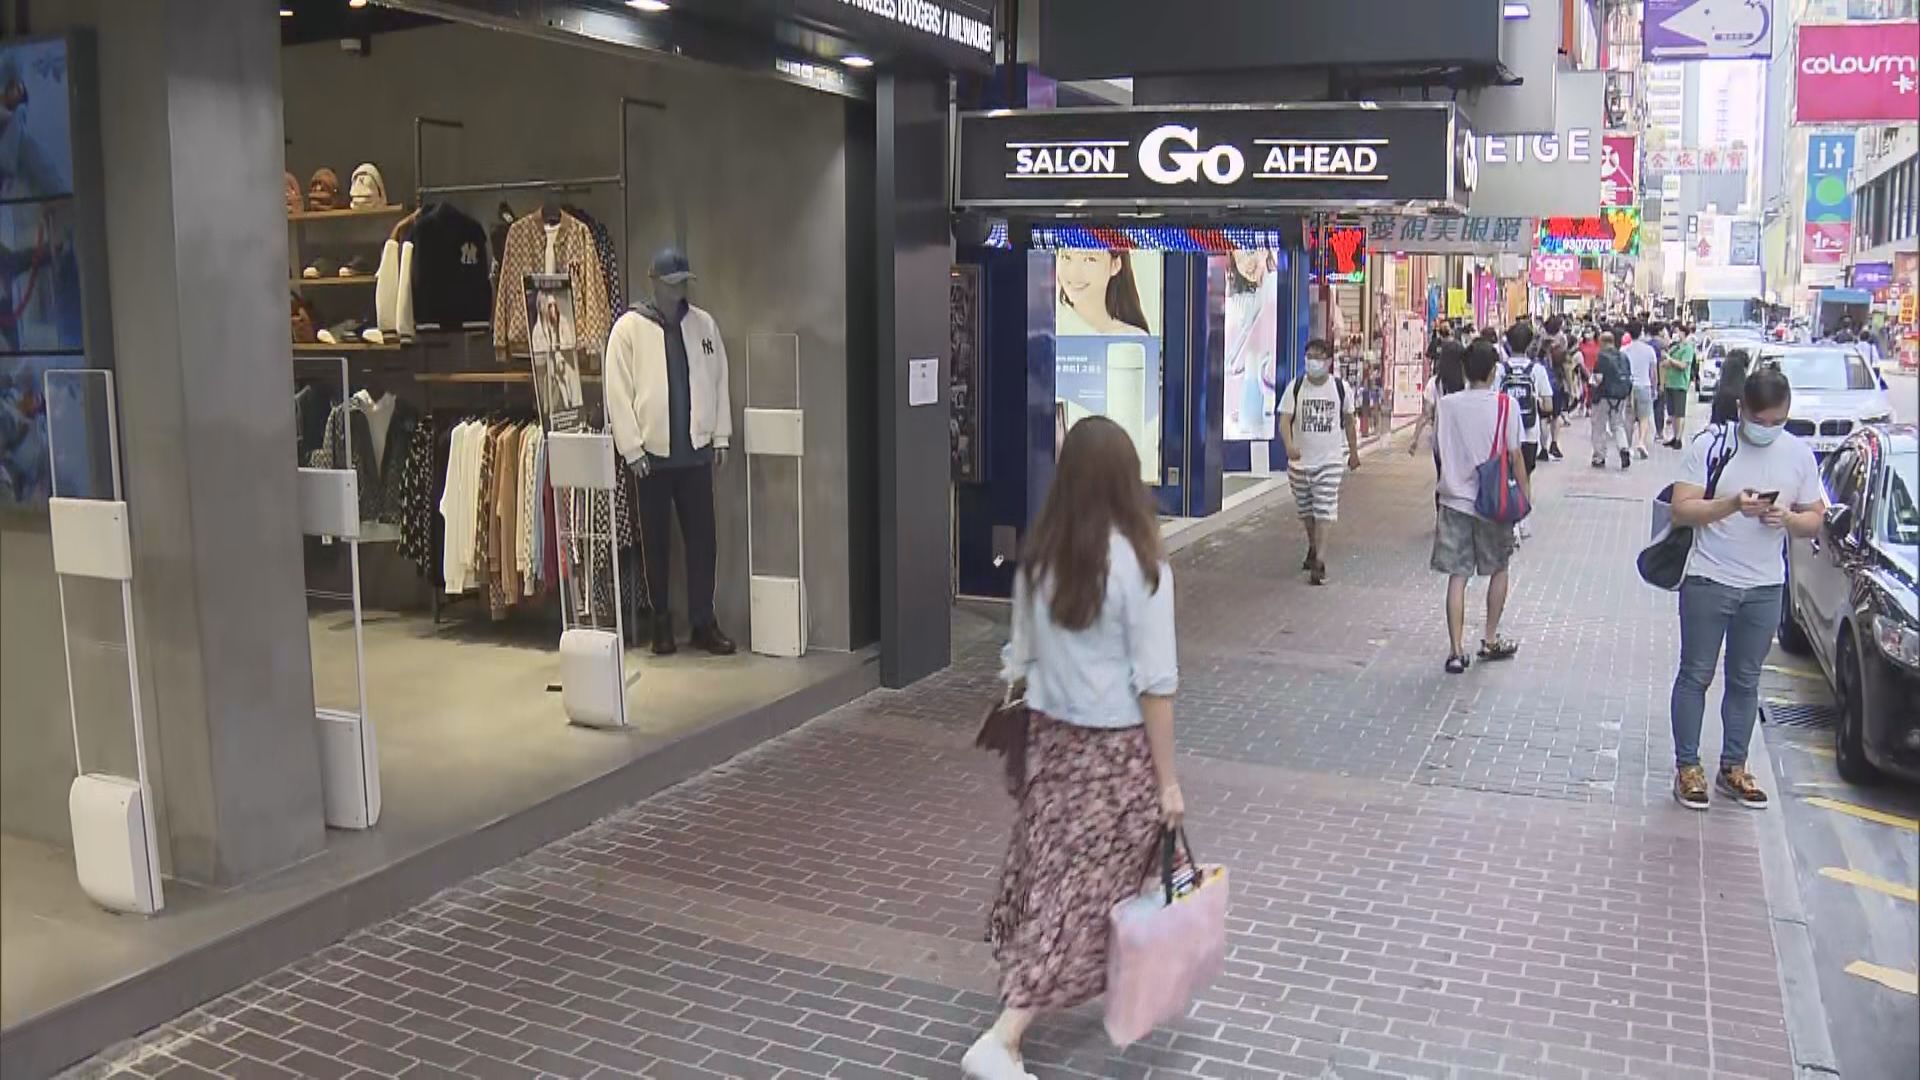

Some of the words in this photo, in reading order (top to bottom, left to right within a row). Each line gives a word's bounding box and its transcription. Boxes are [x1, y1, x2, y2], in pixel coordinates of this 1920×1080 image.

[897, 0, 941, 36] DODGERS
[1016, 146, 1116, 174] SALON
[1137, 124, 1245, 185] Go
[1262, 146, 1378, 174] AHEAD
